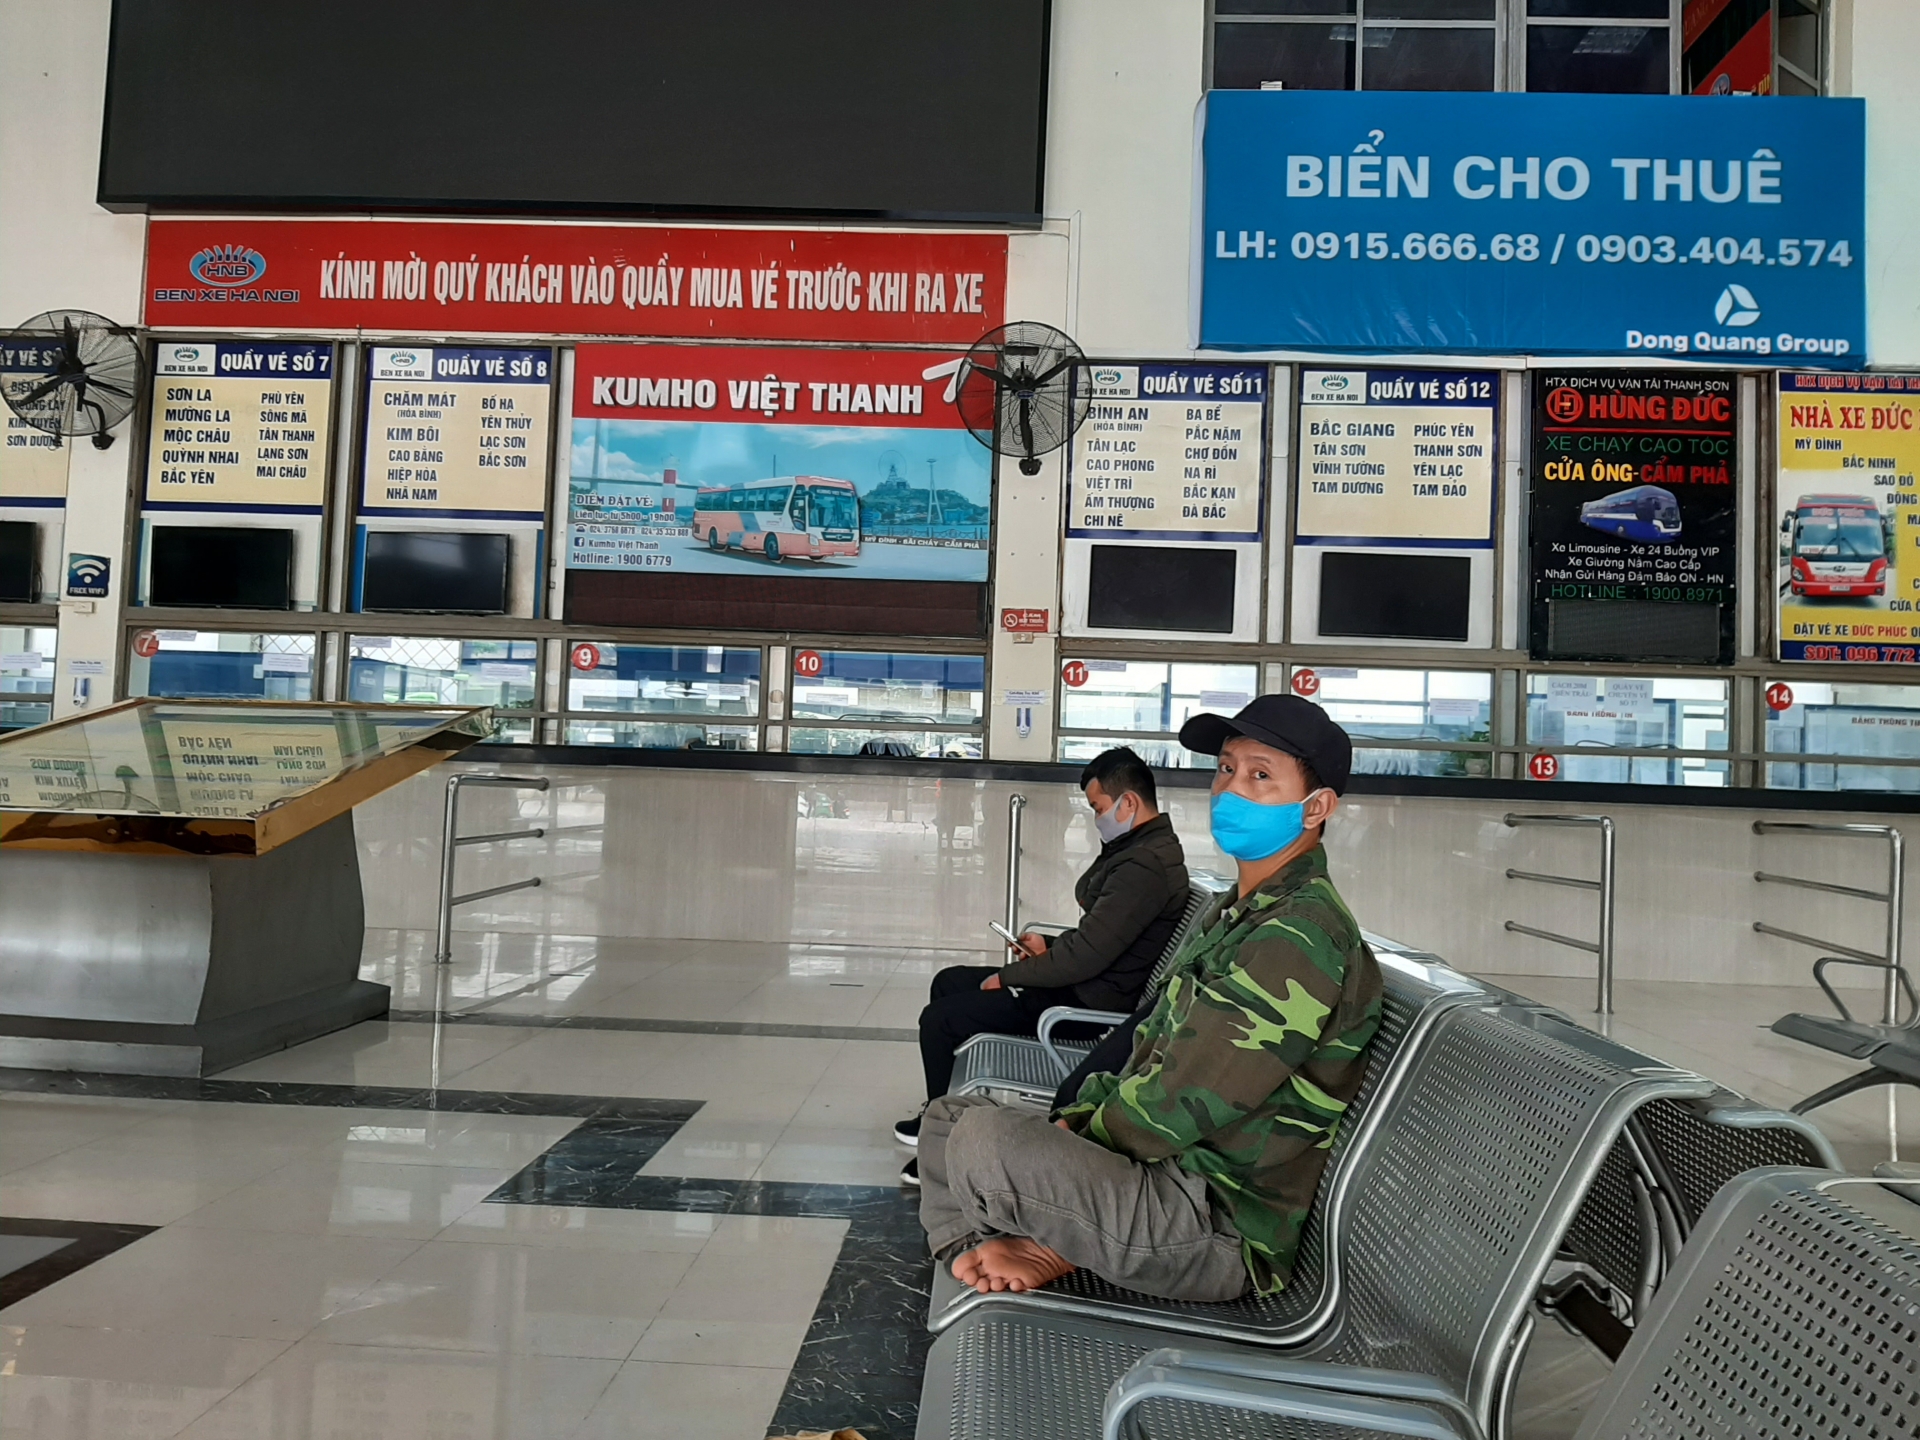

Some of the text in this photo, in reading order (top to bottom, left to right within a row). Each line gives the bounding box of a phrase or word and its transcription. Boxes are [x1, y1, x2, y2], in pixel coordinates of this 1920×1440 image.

[1286, 129, 1781, 203] BIỂN CHO THUÊ
[1216, 230, 1852, 267] LH: 0915.666.68 / 0903.404.574
[207, 266, 248, 276] HNB
[320, 251, 984, 313] KÍNH MỜI QUÝ KHÁCH VÀO QUẦY MUA VÉ TRƯỚC KHI RA XE
[155, 290, 299, 302] BEN XE HA NOI
[1626, 330, 1849, 356] Dong Quang Group
[221, 348, 329, 372] QUẦY VÉ SỐ 7
[438, 354, 547, 377] QUẦY VÉ SỐ 8
[1144, 371, 1189, 395] QUẦY
[1194, 374, 1214, 394] VÉ
[1370, 376, 1490, 400] QUẦY VÉ SỐ 12
[1546, 377, 1567, 387] HTX
[1570, 378, 1597, 389] DỊCH
[1600, 379, 1615, 389] VỤ
[1618, 378, 1641, 390] VẬN
[1664, 380, 1701, 390] THANH
[1705, 380, 1729, 391] SƠN
[167, 388, 212, 401] SƠN LA
[384, 391, 456, 407] CHĂM MÁT
[592, 374, 922, 418] KUMHO VIỆT THANH
[1088, 404, 1148, 420] BÌNH AN
[1589, 389, 1730, 421] HÙNG ĐỨC
[165, 406, 230, 422] MƯỜNG LA
[1790, 399, 1913, 430] NHÀ XE ĐỨC
[259, 429, 314, 441] TÂN THANH
[1311, 419, 1395, 436] BẮC GIANG
[1414, 423, 1474, 437] PHÚC YÊN
[164, 428, 230, 444] MỘC CHÂU
[480, 436, 526, 450] LẠC SƠN
[1795, 437, 1841, 450] MỸ ĐÌNH
[1313, 442, 1366, 455] TÂN SƠN
[1414, 445, 1482, 456] THANH SƠN
[1546, 436, 1571, 450] XE
[1579, 437, 1633, 454] CHẠY
[1640, 438, 1681, 453] CAO
[162, 448, 239, 464] QUỲNH NHAI
[258, 448, 308, 461] LẠNG SƠN
[389, 446, 443, 462] CAO BẰNG
[479, 452, 527, 467] BẮC SƠN
[1843, 453, 1895, 468] BẮC NINH
[257, 465, 306, 478] MAI CHÂU
[1086, 459, 1155, 471] CAO PHONG
[1313, 461, 1385, 475] VĨNH TƯỜNG
[1413, 462, 1463, 479] YÊN LẠC
[1544, 456, 1585, 481] CỬA
[1691, 460, 1730, 484] PHẢ
[161, 468, 214, 484] BẮC YÊN
[1086, 476, 1132, 492] VIỆT TRÌ
[1874, 475, 1895, 485] SAO
[1184, 483, 1235, 501] BẮC KẠN
[1312, 481, 1384, 494] TAM DƯƠNG
[1413, 479, 1467, 496] TAM ĐẢO
[577, 490, 604, 505] ĐIỂM
[609, 495, 631, 508] ĐẶT
[1084, 513, 1124, 527] CHI NÊ
[589, 540, 615, 548] Kumho
[636, 541, 658, 549] Thanh
[1552, 543, 1565, 552] Xe
[1569, 544, 1621, 553] Limousine
[1631, 545, 1644, 554] Xe
[1648, 545, 1660, 554] 24
[1701, 547, 1719, 555] VIP
[573, 553, 671, 566] Hotline: 1900 6779
[1552, 584, 1626, 598] HOTLINE
[1644, 587, 1723, 600] 1900.8971
[1794, 623, 1907, 637] ĐẶT VÉ XE ĐỨC PHÚC
[141, 635, 153, 652] 7
[580, 648, 592, 666] 9
[1846, 646, 1878, 661] 096
[1882, 647, 1915, 662] 772
[800, 657, 819, 671] 10
[1066, 667, 1083, 681] 11
[1295, 675, 1315, 689] 12
[1770, 689, 1790, 703] 14
[1535, 757, 1554, 776] 13
